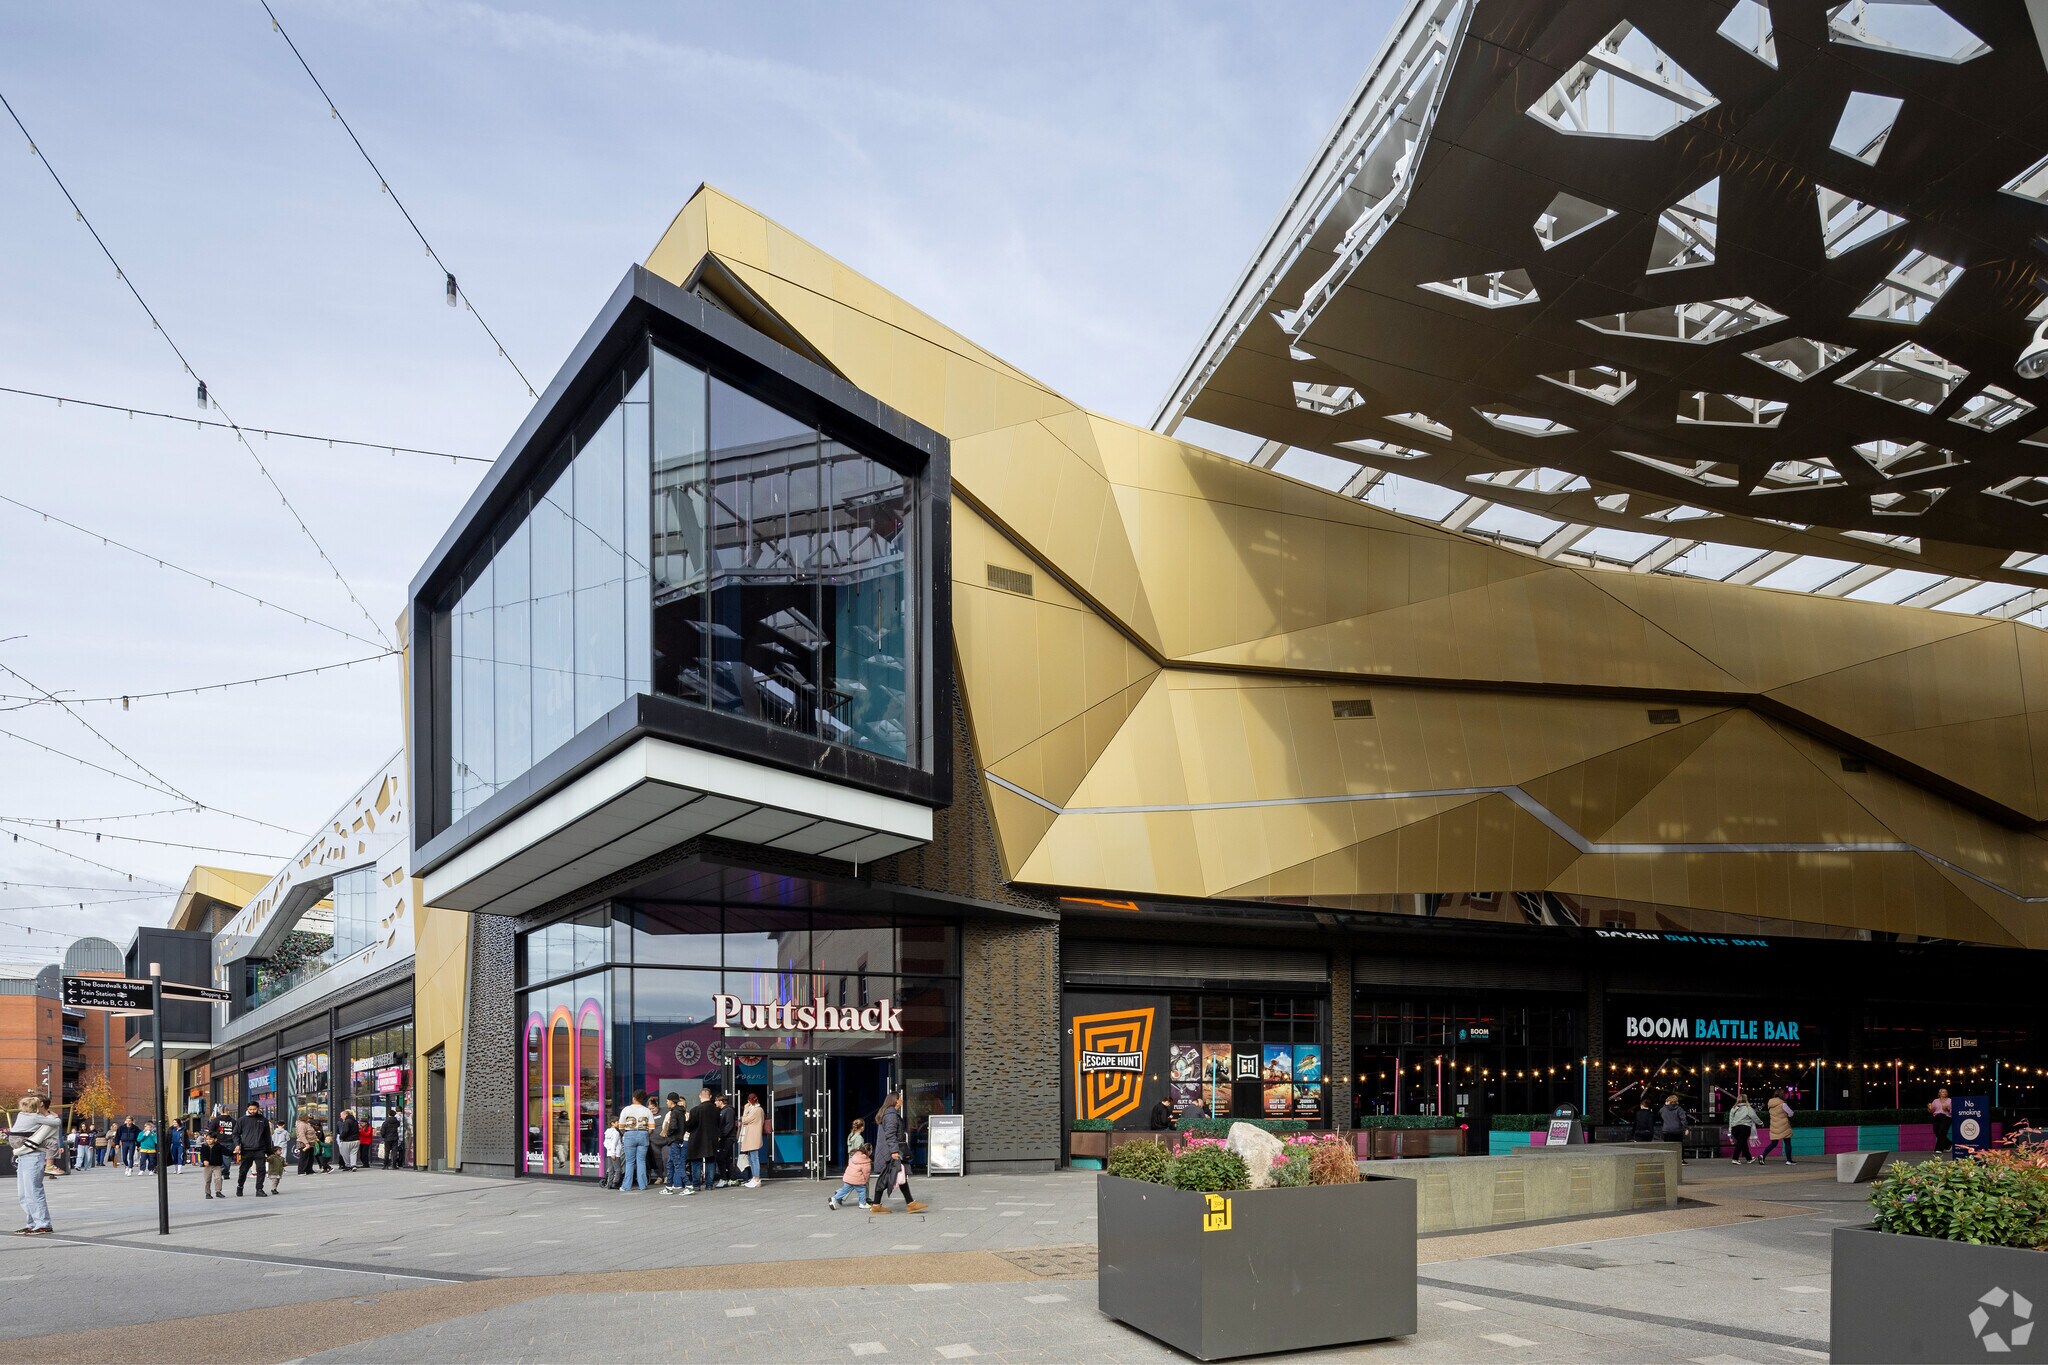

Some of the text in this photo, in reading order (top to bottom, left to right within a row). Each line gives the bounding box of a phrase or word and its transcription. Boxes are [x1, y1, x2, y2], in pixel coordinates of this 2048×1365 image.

[92, 981, 122, 989] Boardwalk
[200, 990, 222, 999] Shopping
[713, 993, 904, 1032] Puttshack
[1626, 1016, 1800, 1040] BOOM BATTLE BAR
[1086, 1055, 1139, 1068] ESCAPE HUNT
[1241, 1059, 1255, 1073] EH
[1958, 1109, 1982, 1118] smoking
[526, 1150, 545, 1161] Puttshack
[578, 1152, 601, 1163] Puttshack
